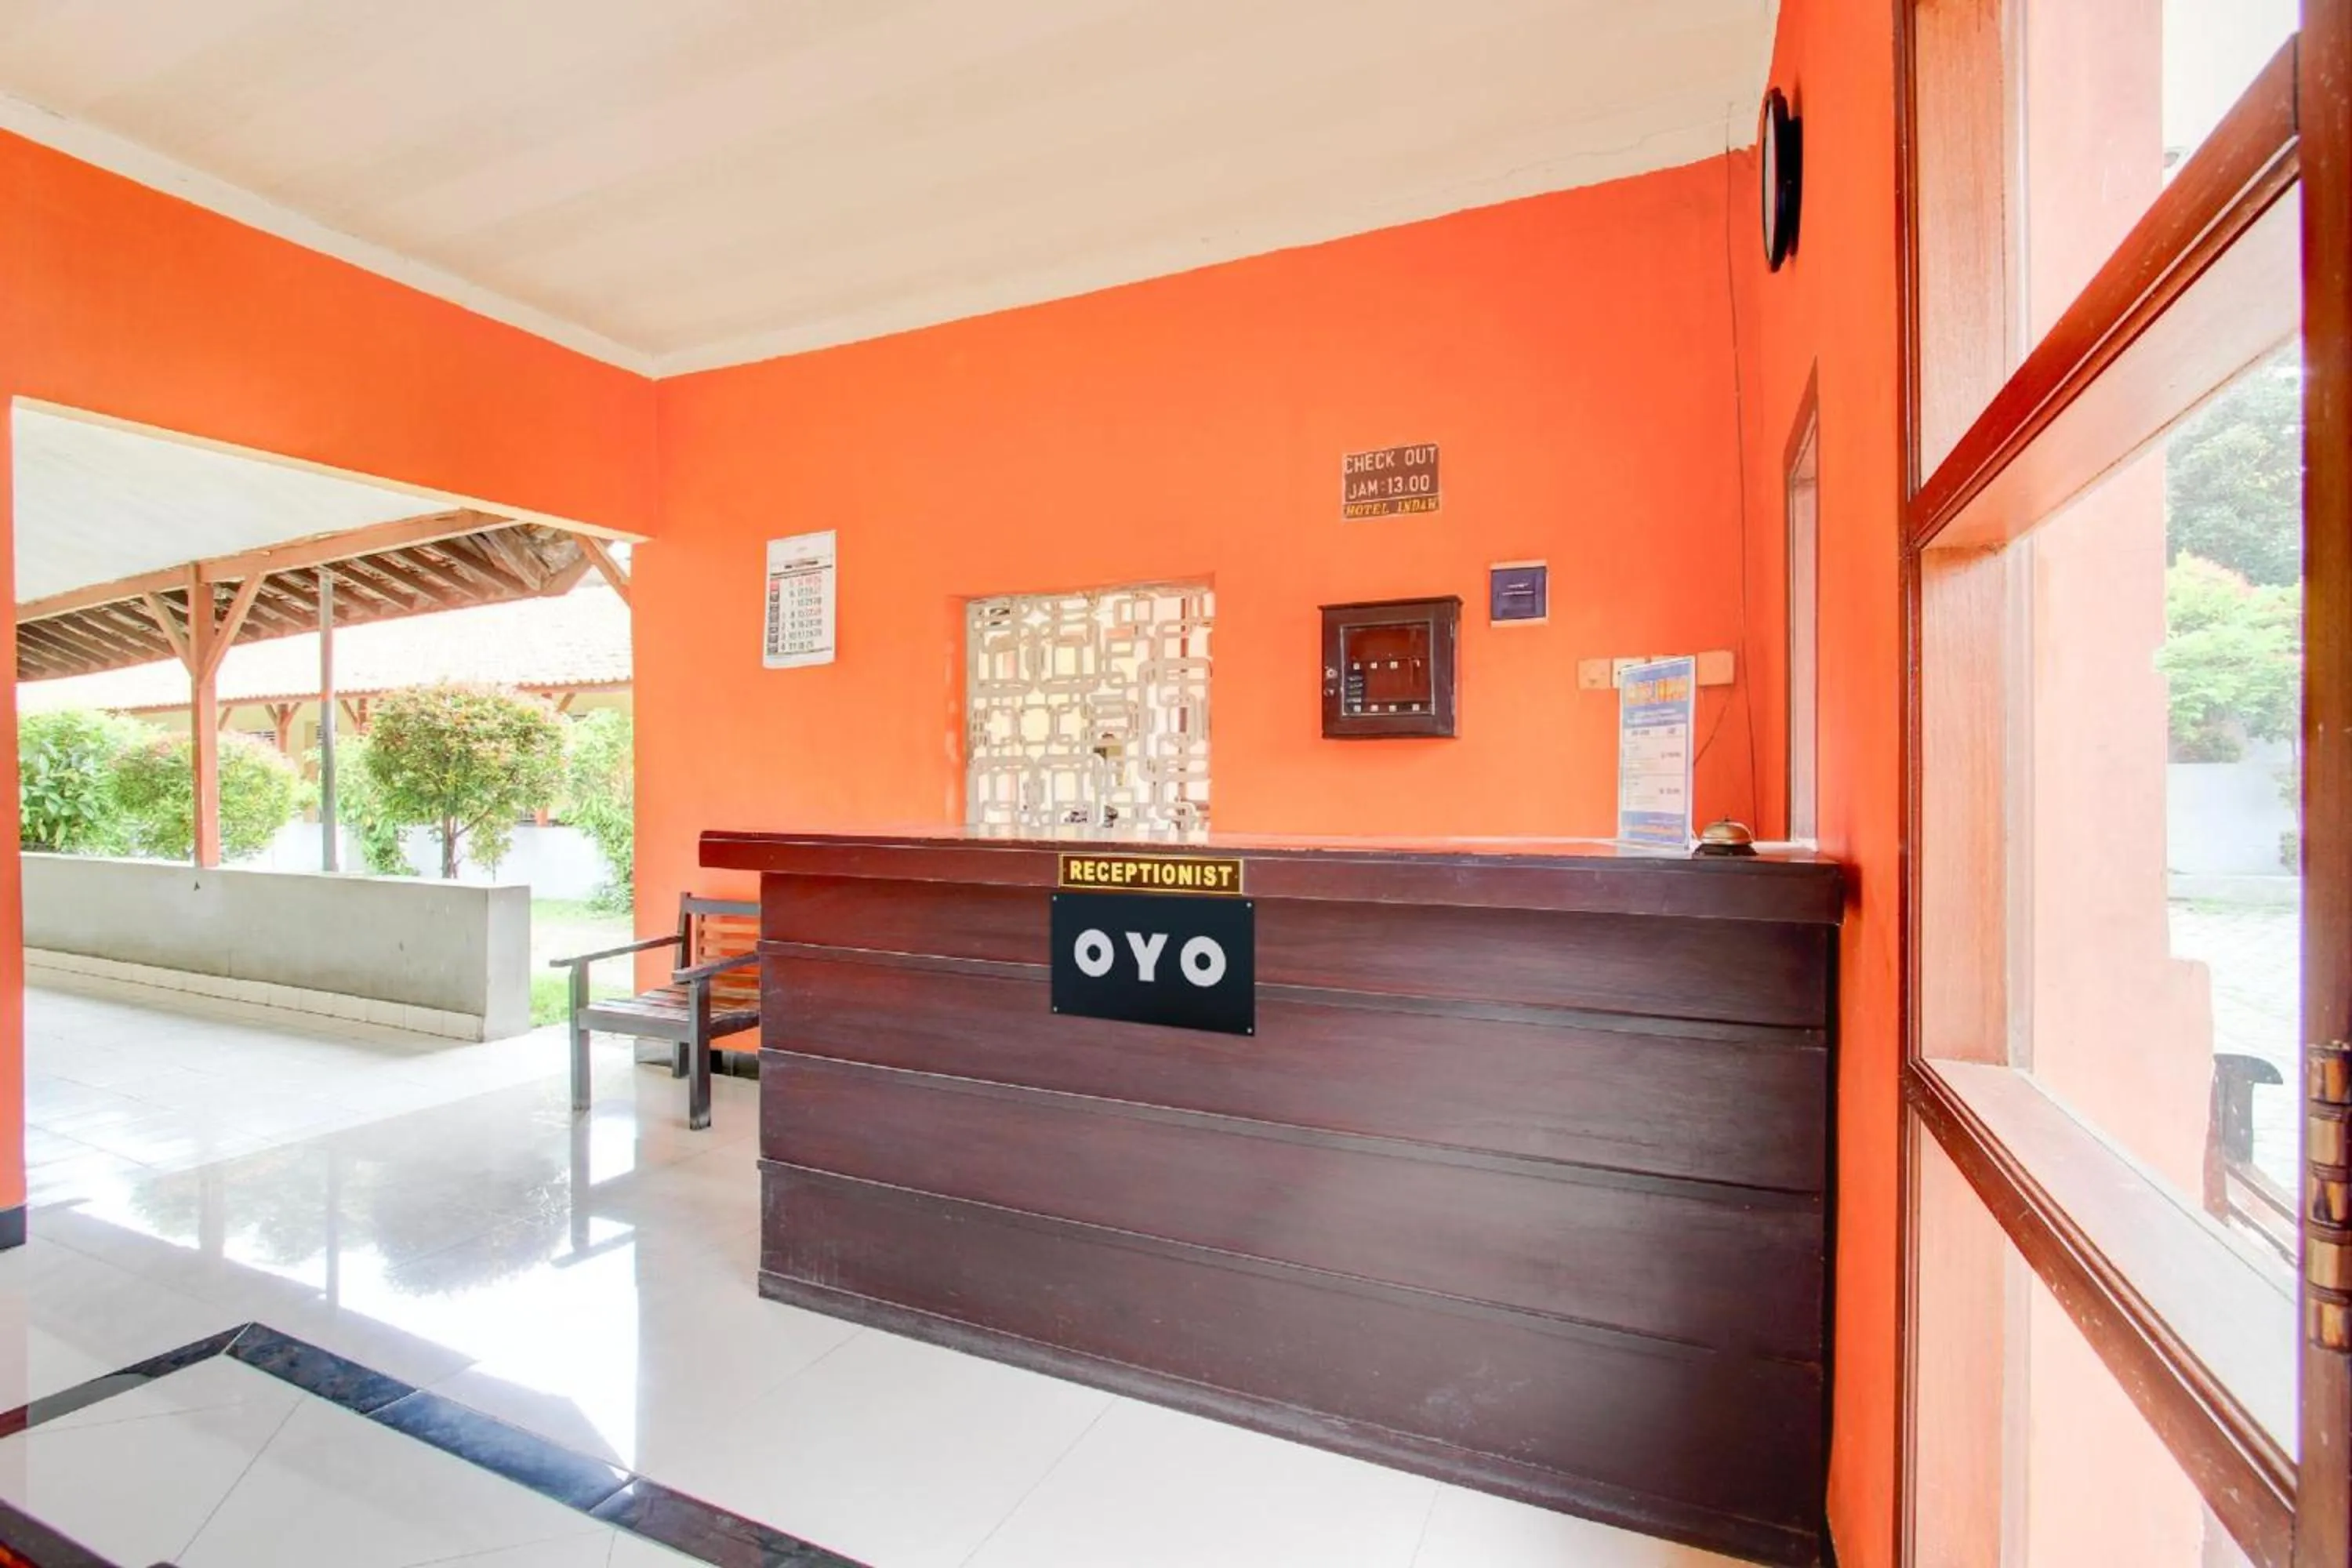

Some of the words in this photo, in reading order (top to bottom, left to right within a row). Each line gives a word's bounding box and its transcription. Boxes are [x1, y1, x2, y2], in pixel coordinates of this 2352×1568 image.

[1344, 451, 1396, 474] CHECK
[1404, 447, 1436, 466] OUT
[1346, 503, 1390, 516] HOTEL
[1396, 498, 1438, 514] INDAH
[1069, 860, 1232, 887] RECEPTIONIST
[1074, 928, 1227, 987] OYO
